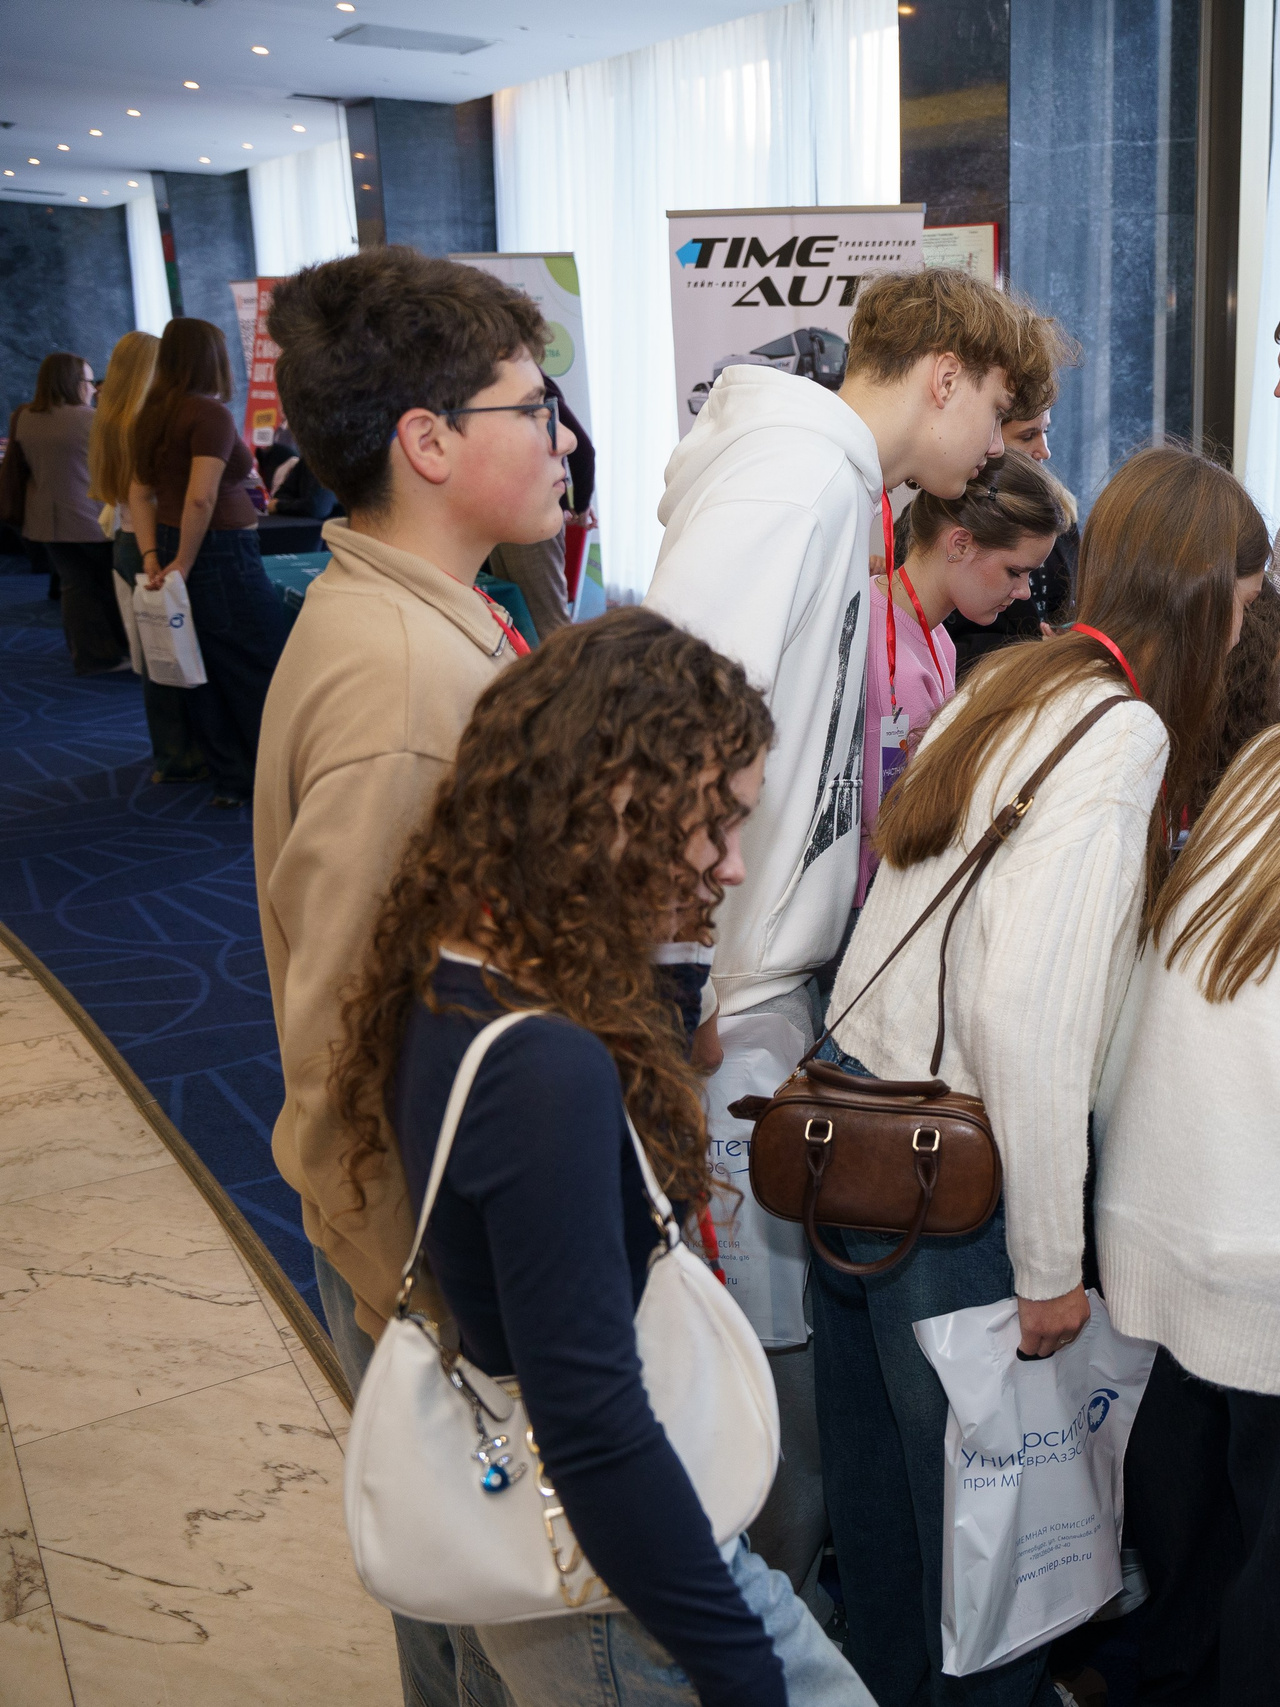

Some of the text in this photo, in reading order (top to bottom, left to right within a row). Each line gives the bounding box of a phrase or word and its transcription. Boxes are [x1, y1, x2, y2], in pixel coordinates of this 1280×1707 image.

[692, 236, 839, 269] TIME
[732, 276, 872, 307] AUT
[963, 1477, 996, 1491] при
[1016, 1514, 1096, 1547] ЕМНАЯ КОМИССИЯ
